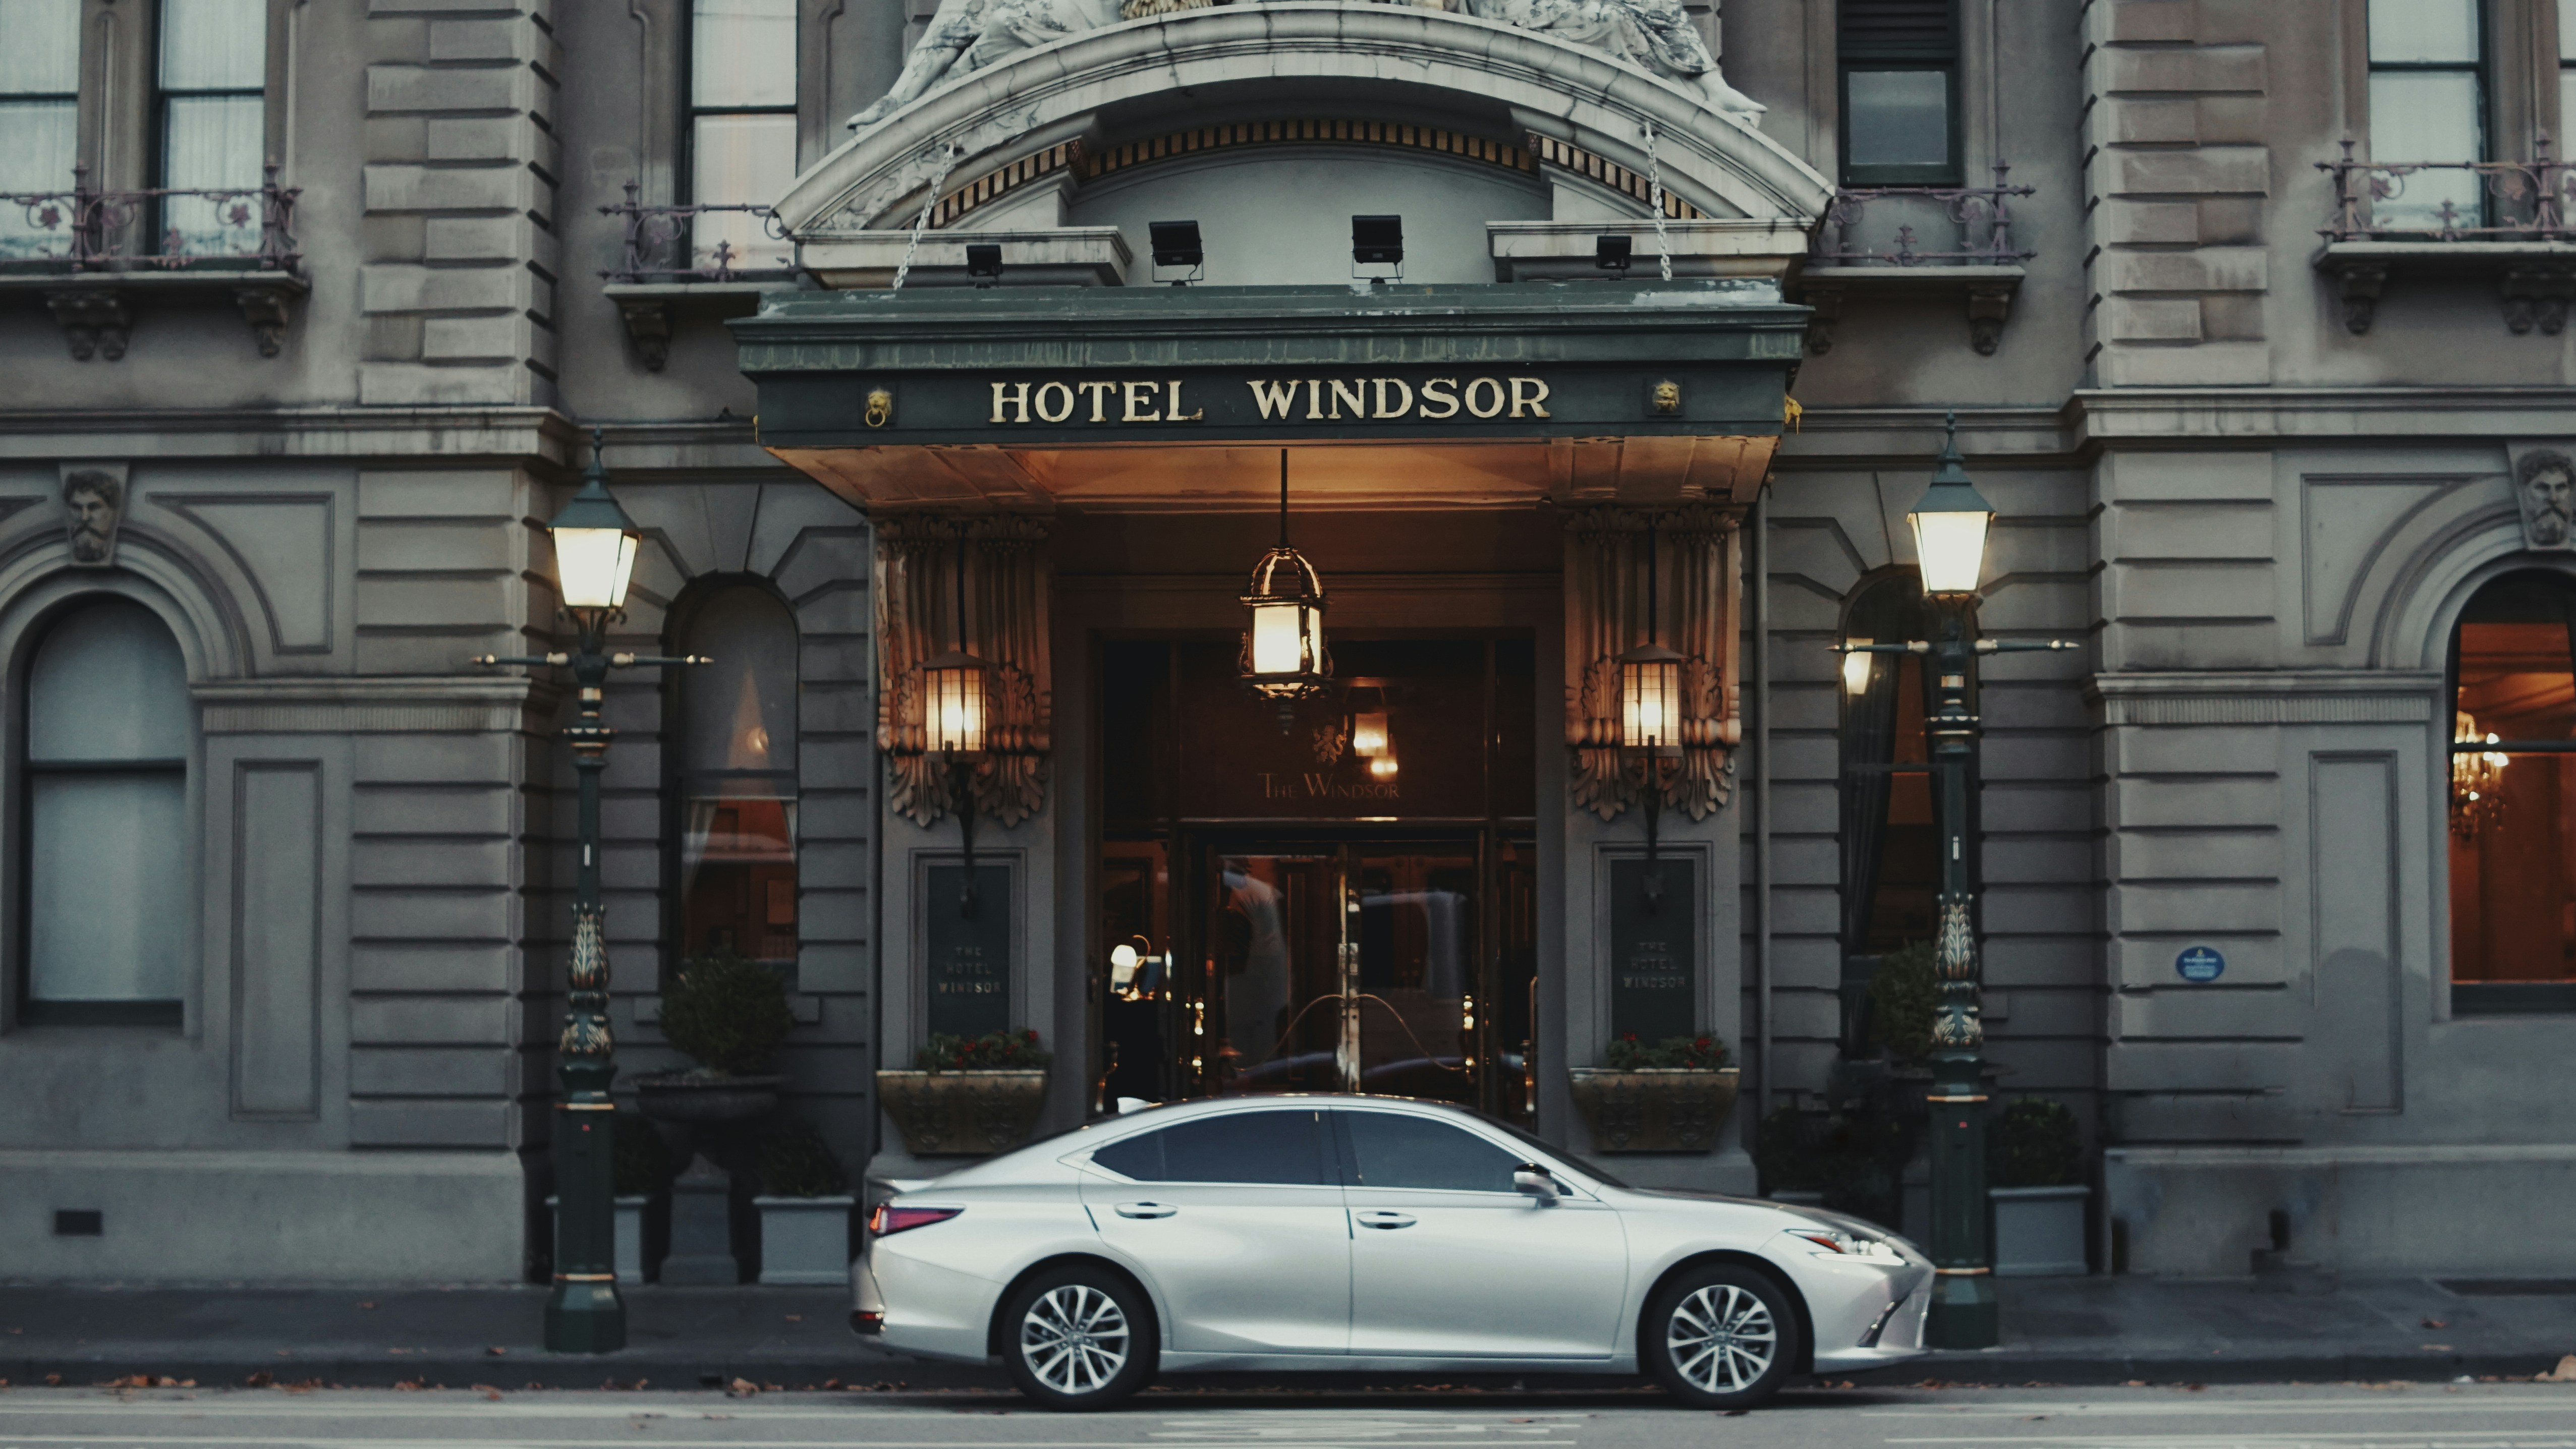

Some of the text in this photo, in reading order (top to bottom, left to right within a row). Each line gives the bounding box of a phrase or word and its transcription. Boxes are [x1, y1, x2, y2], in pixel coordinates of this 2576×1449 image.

[989, 376, 1551, 424] HOTEL WINDSOR
[939, 982, 1001, 993] WINDSOR
